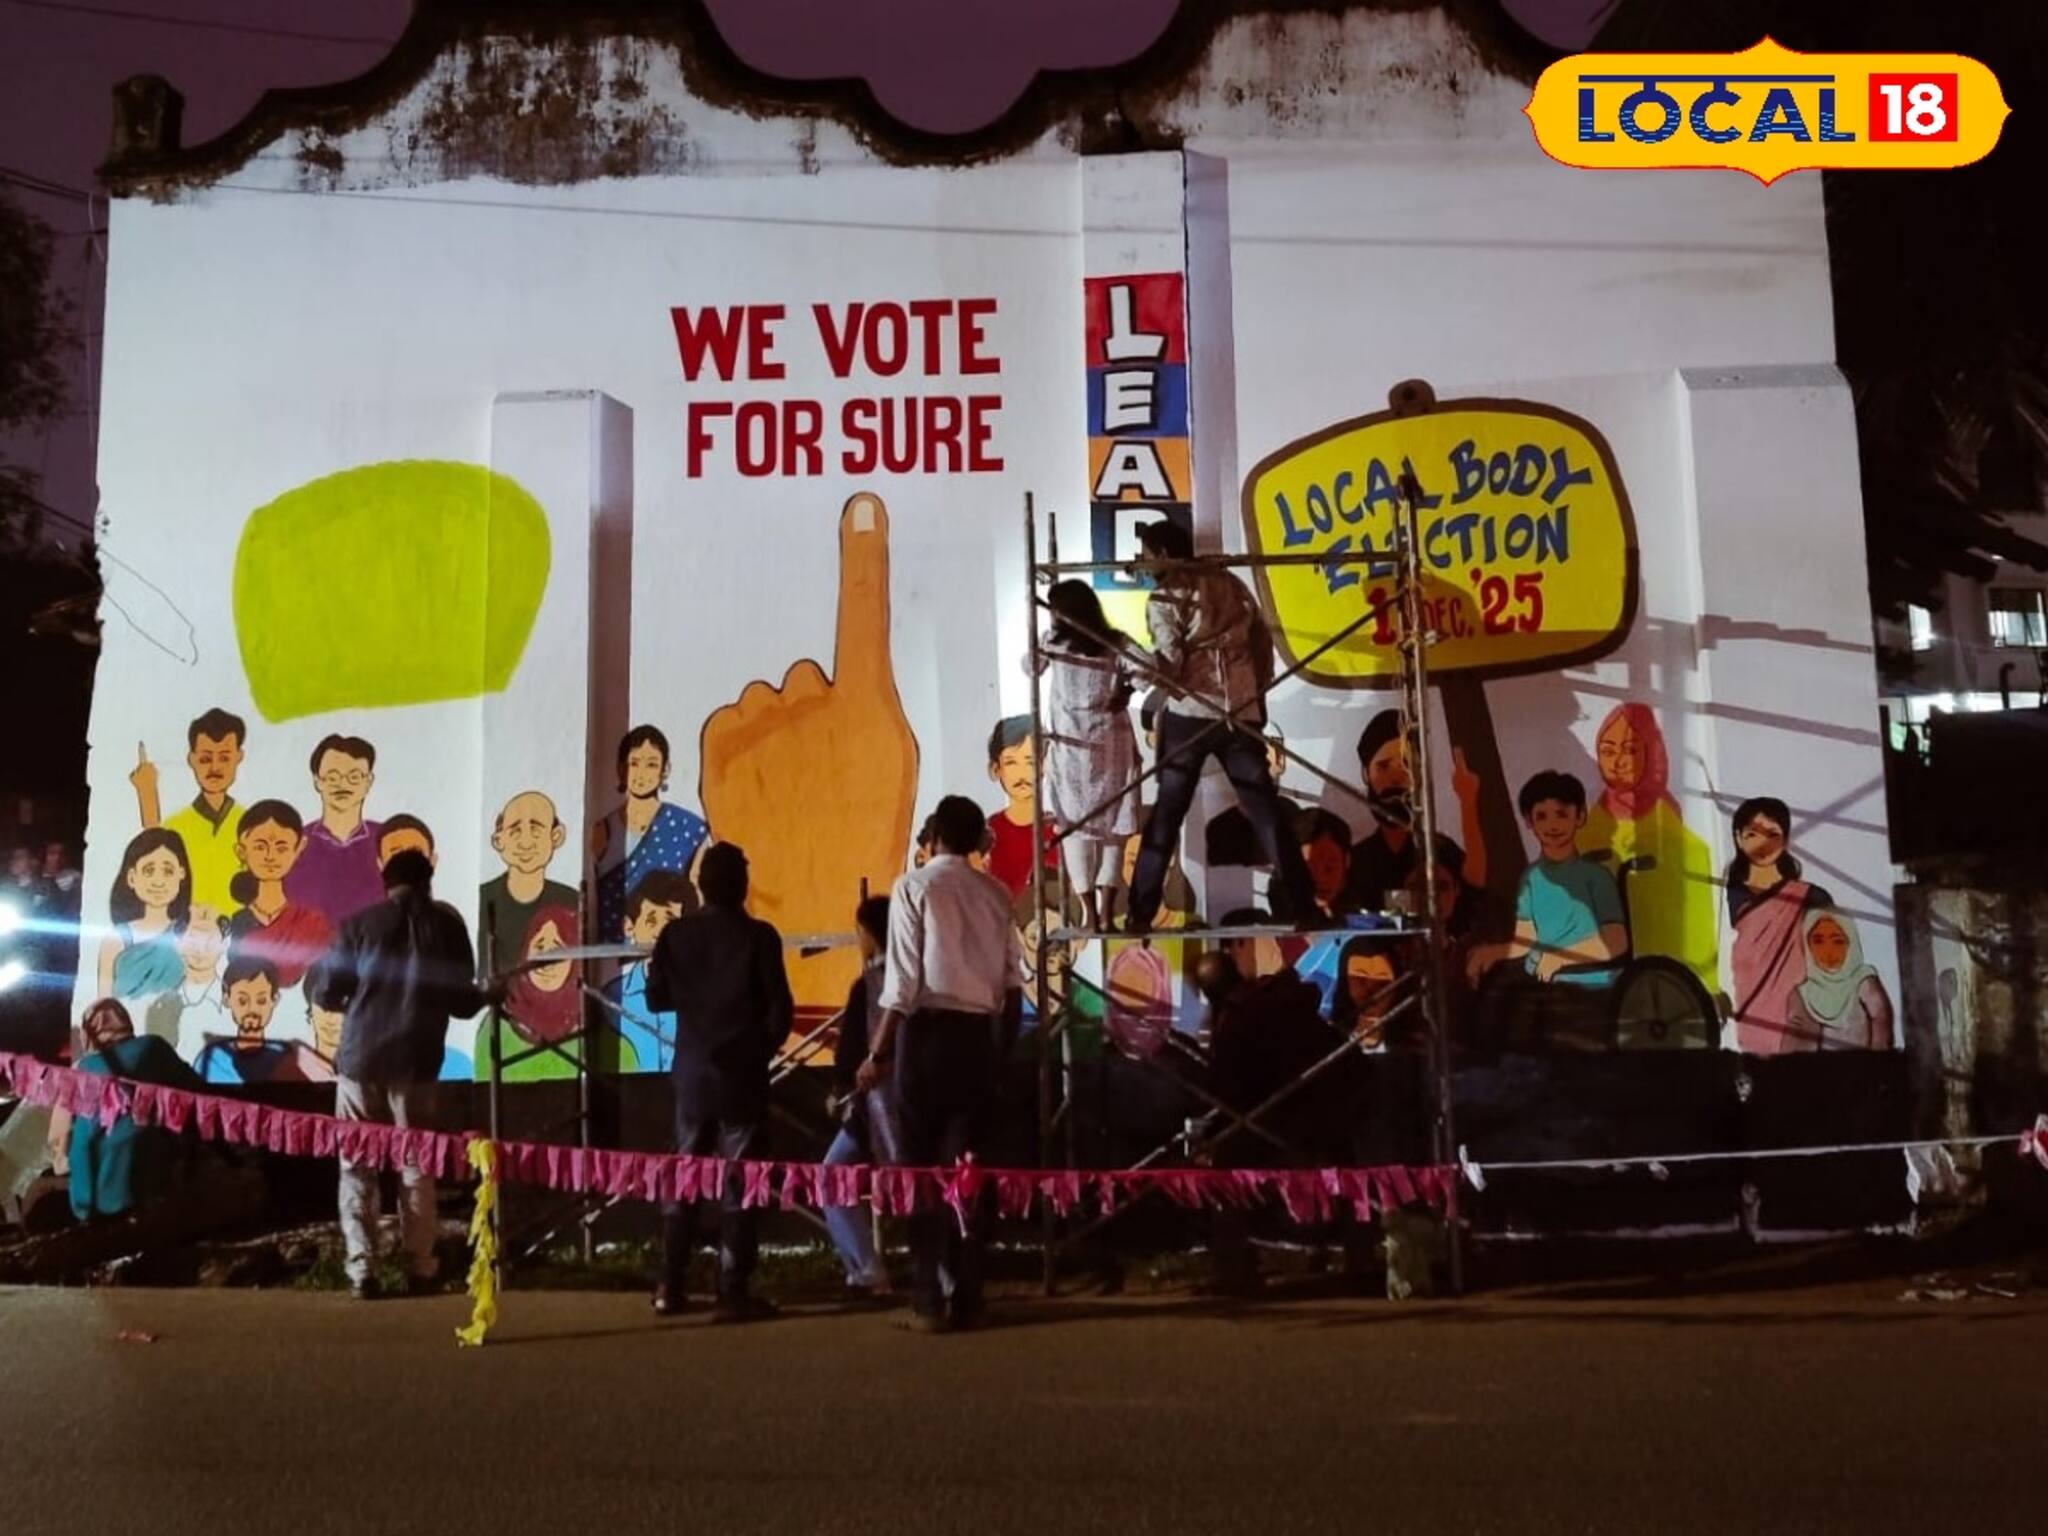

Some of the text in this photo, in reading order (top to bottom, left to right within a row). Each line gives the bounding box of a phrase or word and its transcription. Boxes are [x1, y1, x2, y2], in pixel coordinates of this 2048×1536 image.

[670, 299, 1000, 381] WE VOTE
[687, 395, 1004, 478] FOR SURE
[1449, 440, 1592, 505] BODY
[1321, 505, 1570, 594] ELCTION
[1470, 567, 1543, 634] '25
